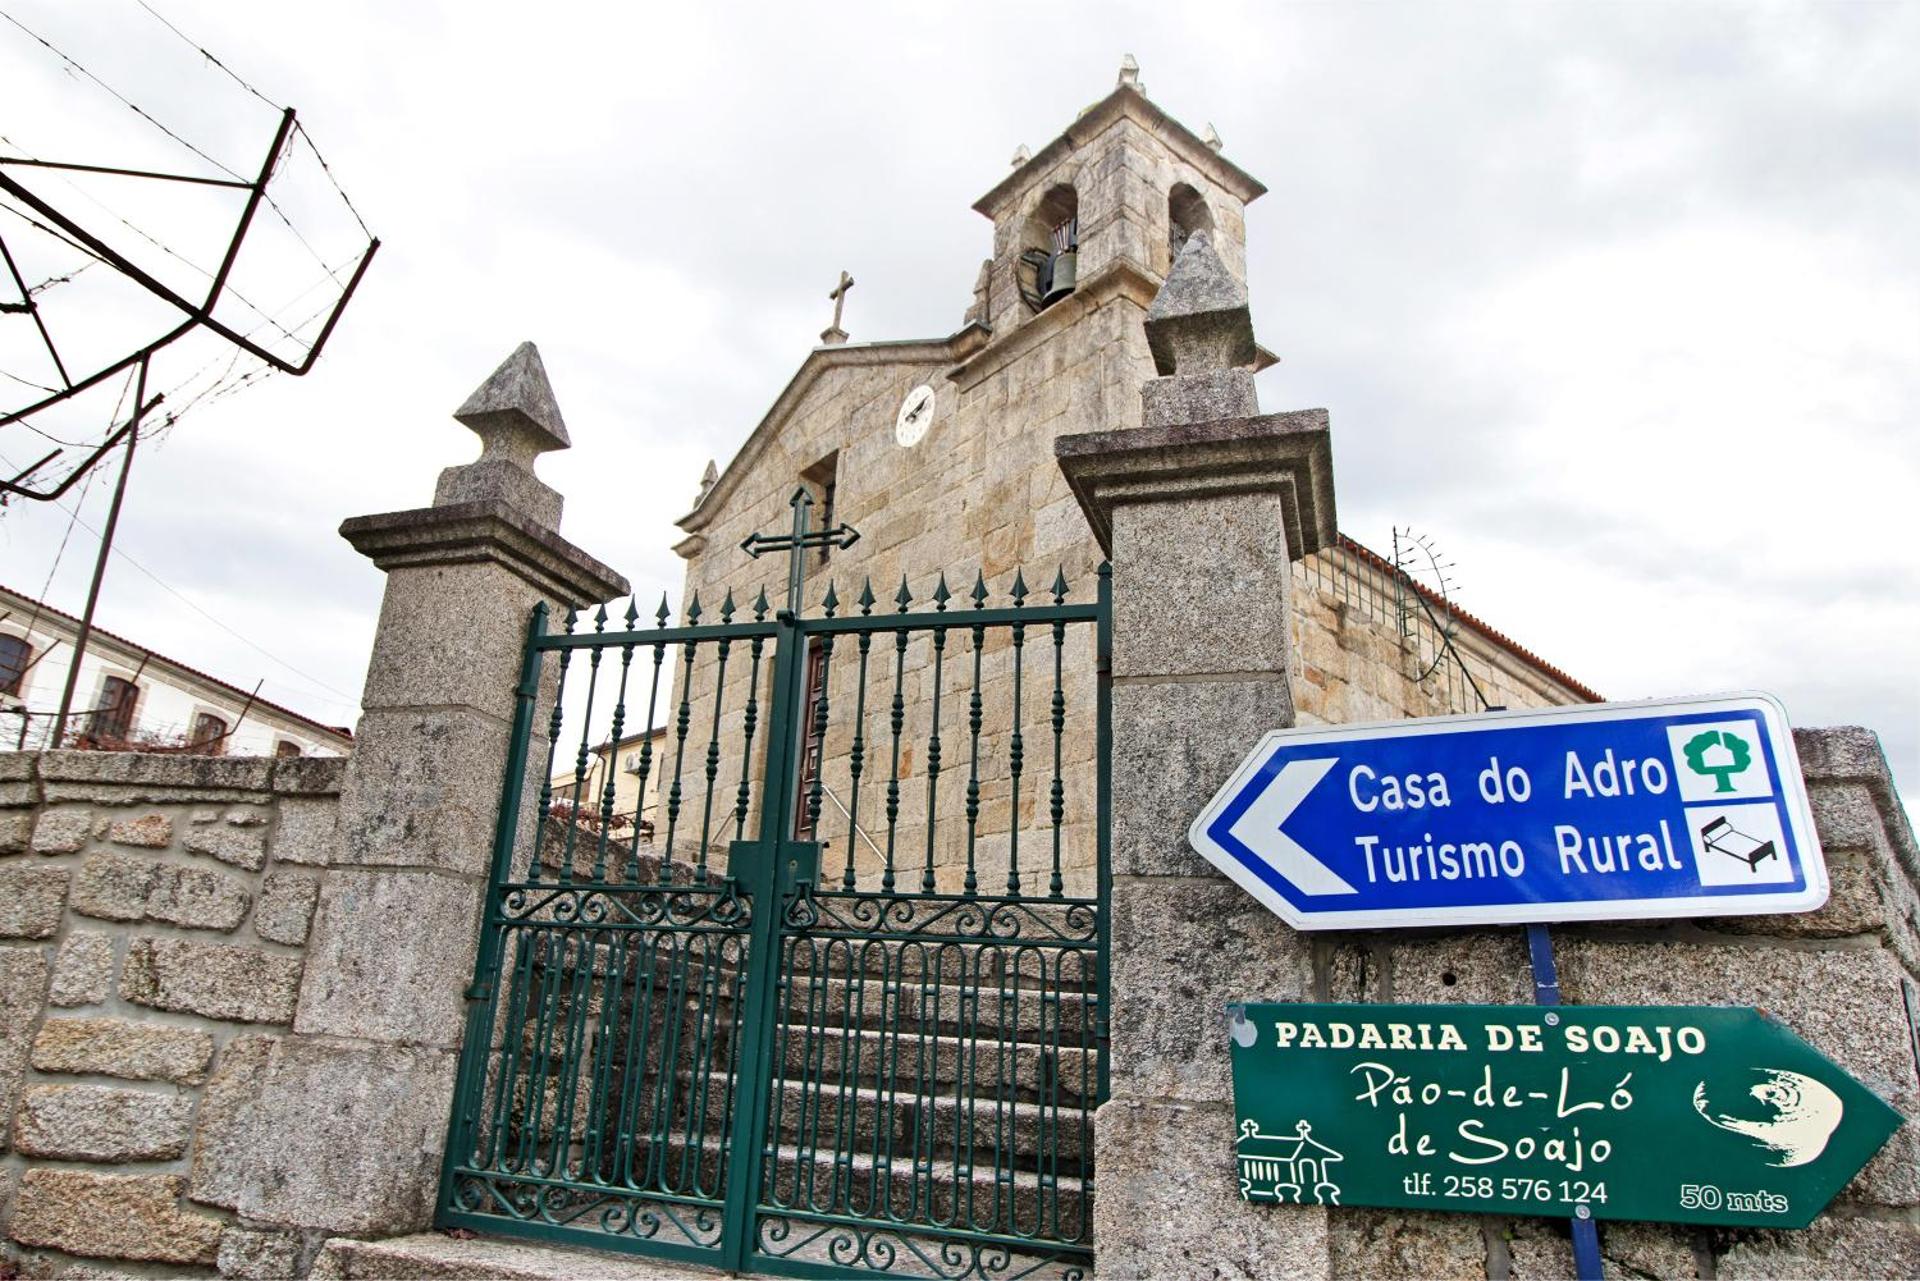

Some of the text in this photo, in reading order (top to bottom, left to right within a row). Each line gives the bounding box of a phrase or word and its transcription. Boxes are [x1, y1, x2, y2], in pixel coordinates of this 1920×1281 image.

[1349, 748, 1668, 812] Casa do Adro
[1355, 819, 1682, 883] Turismo Rural
[1275, 1022, 1706, 1063] PADARIA DE SOAJO
[1350, 1062, 1634, 1118] Pão-de-Ló
[1388, 1112, 1612, 1172] de Soajo
[1402, 1172, 1608, 1204] tlf. 258 576 124
[1679, 1184, 1789, 1213] 50 mts
